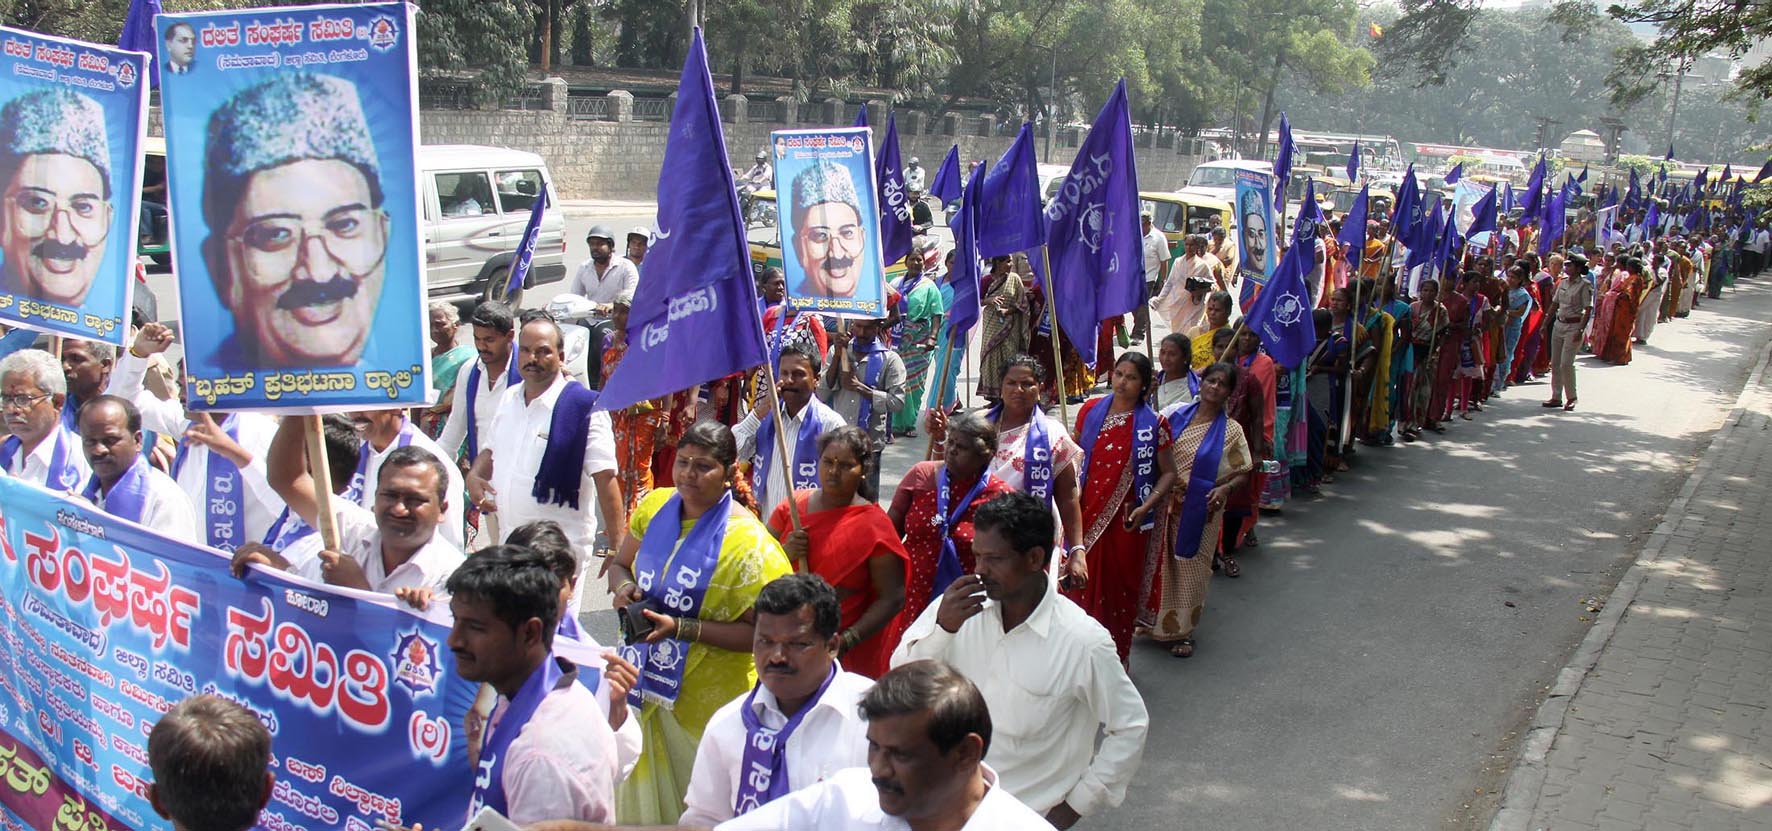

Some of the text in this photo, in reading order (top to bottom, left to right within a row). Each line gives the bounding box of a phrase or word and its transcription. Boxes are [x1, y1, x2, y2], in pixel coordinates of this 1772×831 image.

[5, 37, 33, 59] ದಲಿತ
[35, 42, 76, 69] ಸಂಘರ್ಷ
[79, 51, 109, 73] ಸಮಿತಿ
[202, 21, 240, 47] ದಲಿತ
[247, 19, 303, 47] ಸಂಘರ್ಷ
[311, 16, 355, 42] ಸಮಿತಿ
[264, 371, 356, 400] ಪ್ರತಿಭಟನಾ
[23, 588, 107, 656] (ಸಮತಾವಾದ)
[115, 649, 148, 679] ಜಿಲ್ಲಾ
[24, 520, 199, 648] ಸಂಘರ್ಷ
[226, 598, 389, 727] ಸಮಿತಿ
[411, 713, 449, 758] (ರಿ)
[405, 662, 425, 677] DSS
[50, 641, 115, 688] ನೂತನವಾಗಿ
[287, 757, 325, 781] ಬಸ್
[331, 776, 401, 825] ನಿಲ್ದಾಣಕ್ಕೆ
[91, 694, 133, 728] ಹಾಗೂ
[273, 781, 339, 823] ಮೊದಲ
